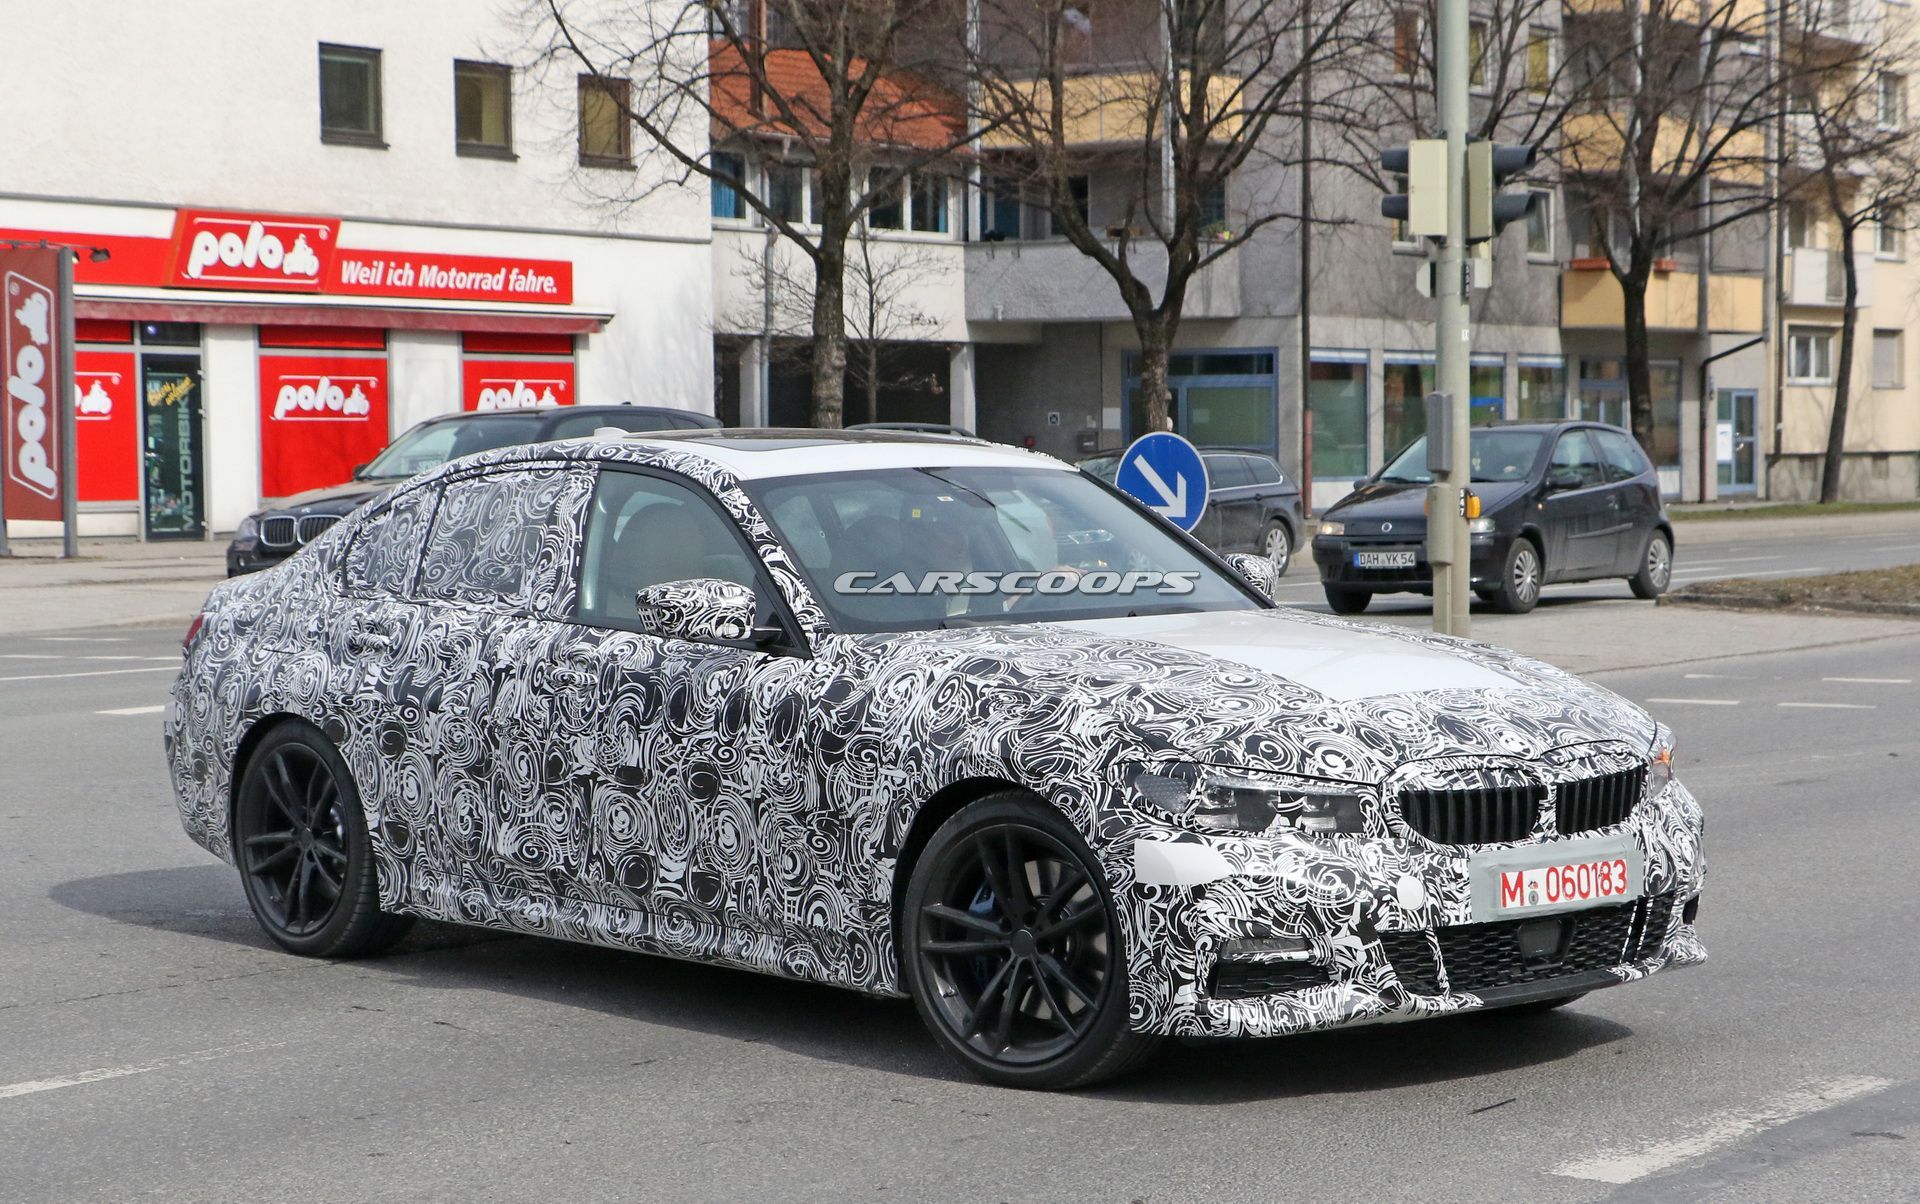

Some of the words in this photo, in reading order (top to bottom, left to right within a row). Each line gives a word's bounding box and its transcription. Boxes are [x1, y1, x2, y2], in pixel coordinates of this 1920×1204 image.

[187, 221, 285, 279] polo
[341, 260, 385, 286] Weil
[386, 262, 415, 287] ich
[418, 264, 507, 291] Motorrad
[508, 268, 558, 294] fahre.
[7, 345, 58, 489] polo
[273, 376, 345, 420] polo
[176, 377, 195, 531] MOTORBIK
[1360, 553, 1379, 565] DAH
[1386, 553, 1399, 565] YK
[1401, 553, 1414, 565] 54
[1501, 870, 1524, 908] M
[1546, 859, 1628, 903] 060183
